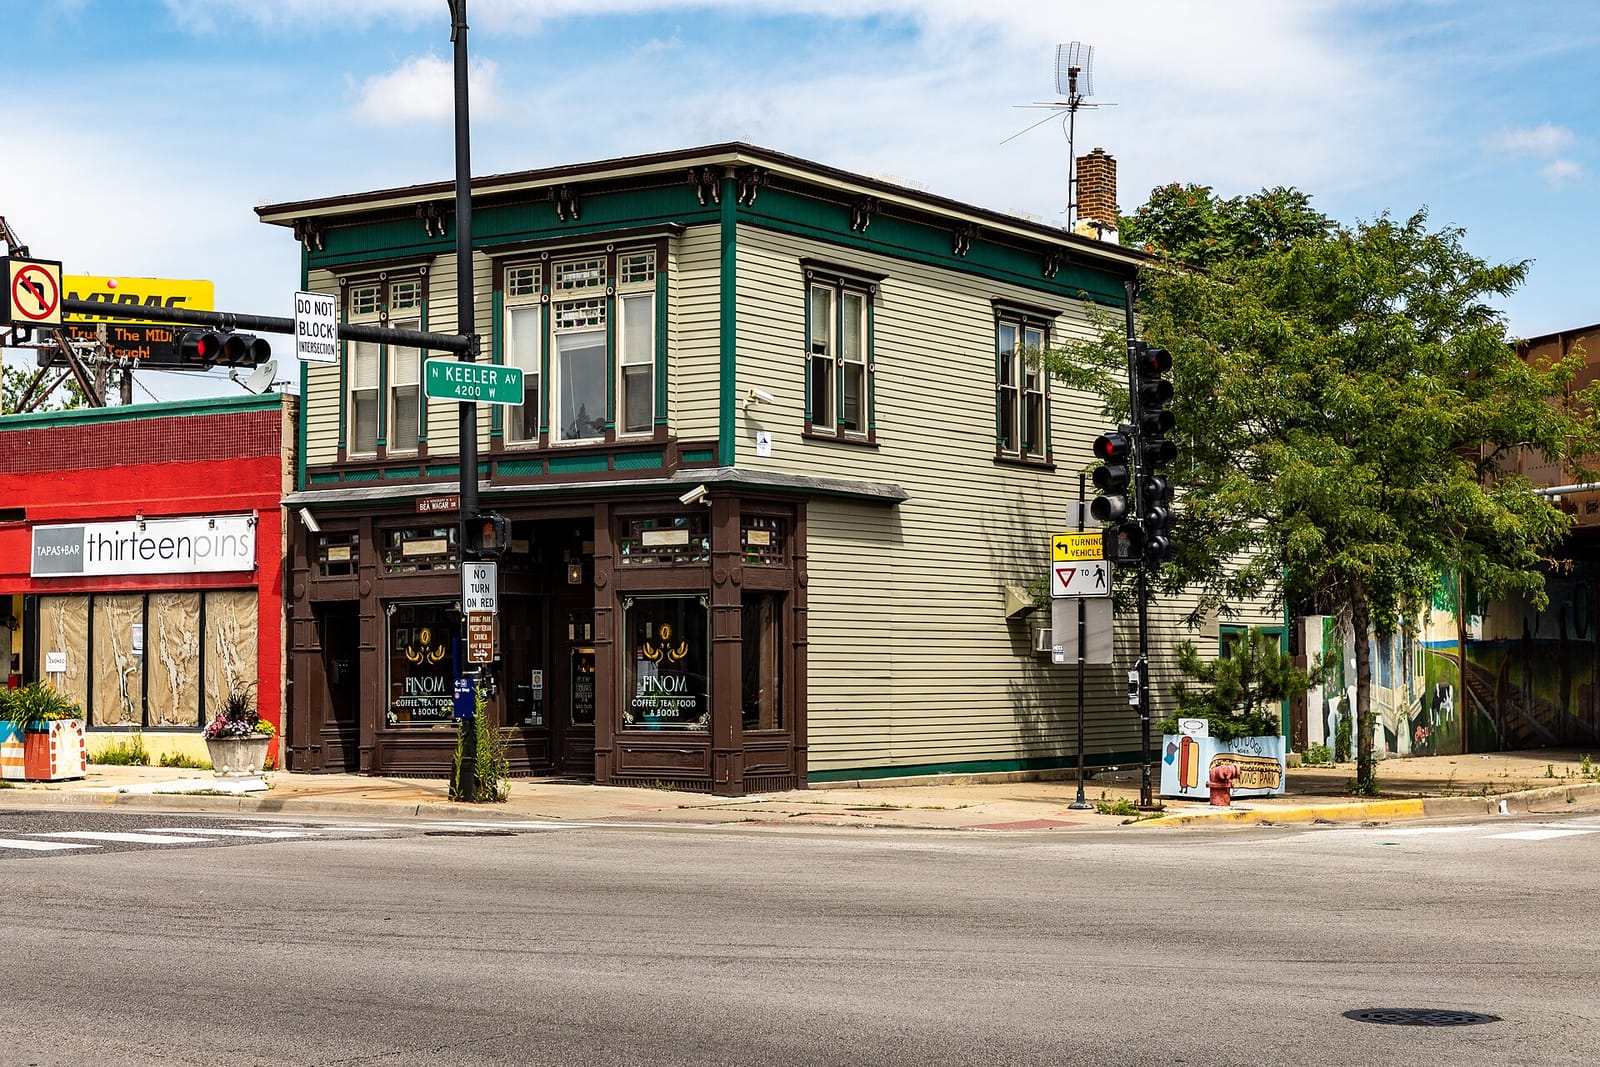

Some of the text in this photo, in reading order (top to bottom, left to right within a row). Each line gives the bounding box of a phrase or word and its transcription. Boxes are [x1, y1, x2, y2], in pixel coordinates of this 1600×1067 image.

[297, 299, 333, 317] DO NOT
[114, 327, 140, 343] The
[299, 321, 333, 339] BLOCK
[299, 341, 335, 356] INTERSECTION
[432, 366, 517, 385] N KEELER AV
[454, 385, 496, 399] 4200 W
[419, 503, 431, 511] BEA
[1070, 548, 1103, 557] VEHICLE
[473, 569, 487, 580] NO
[1081, 569, 1090, 577] TO
[470, 583, 490, 594] TURN
[466, 598, 495, 608] ON RED
[405, 676, 445, 692] FINOM
[643, 675, 688, 692] FINOM
[676, 699, 696, 708] FOOD
[418, 708, 438, 716] BOOKS
[656, 708, 679, 717] BOOKS
[1259, 770, 1276, 786] PARK
